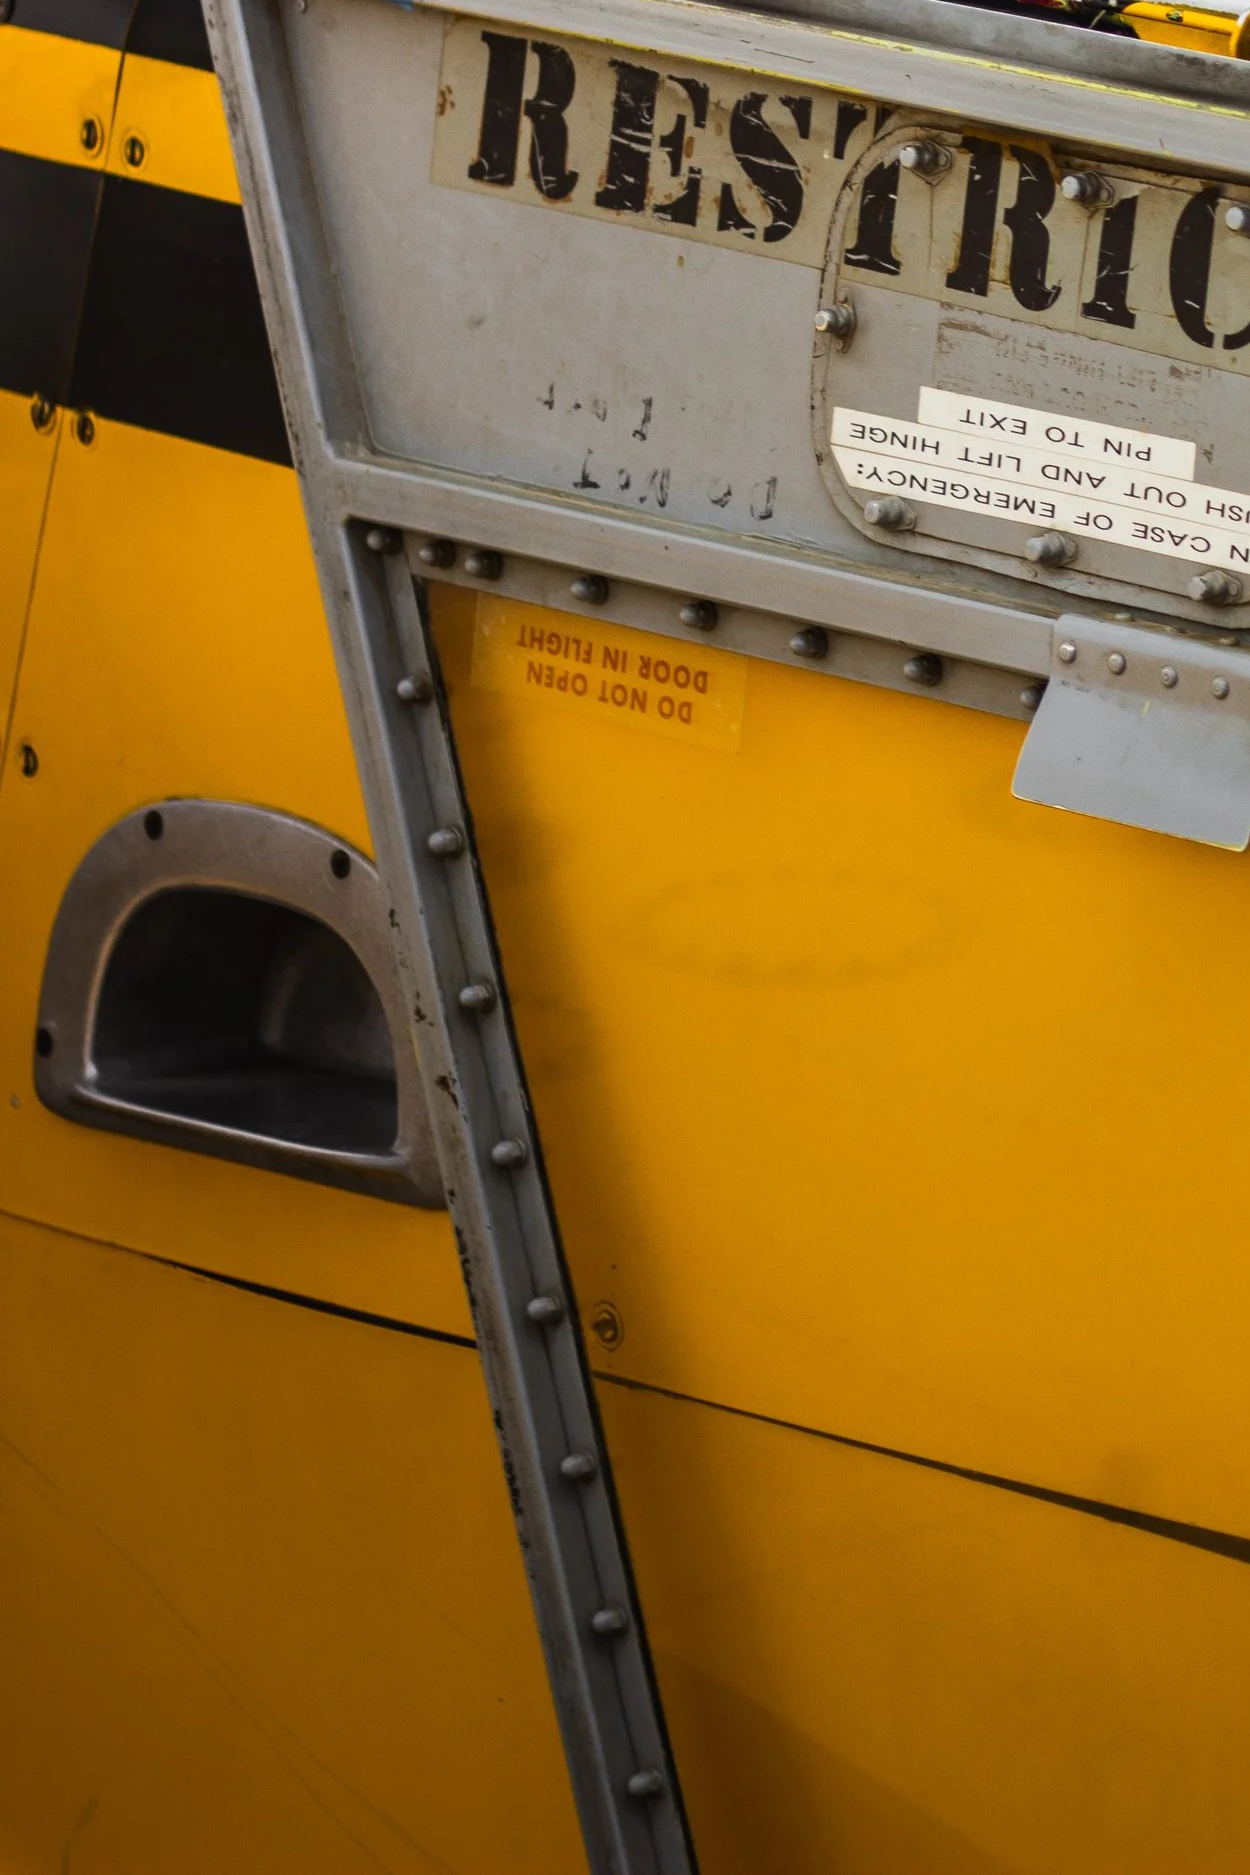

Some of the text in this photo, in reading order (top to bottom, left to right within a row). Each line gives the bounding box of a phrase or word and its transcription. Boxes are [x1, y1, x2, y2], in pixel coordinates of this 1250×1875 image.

[849, 422, 941, 456] HINGE
[958, 408, 1153, 462] PIN TO EXIT
[957, 446, 1022, 473] LIFT
[1040, 462, 1107, 490] AND
[856, 462, 1057, 519] EMERGENCY:
[1123, 481, 1188, 509] OUT
[1073, 510, 1114, 532] OF
[1131, 521, 1212, 554] CASE
[516, 625, 709, 695] DOOR IN FLIGHT
[526, 660, 693, 725] DO NOT OPEN
